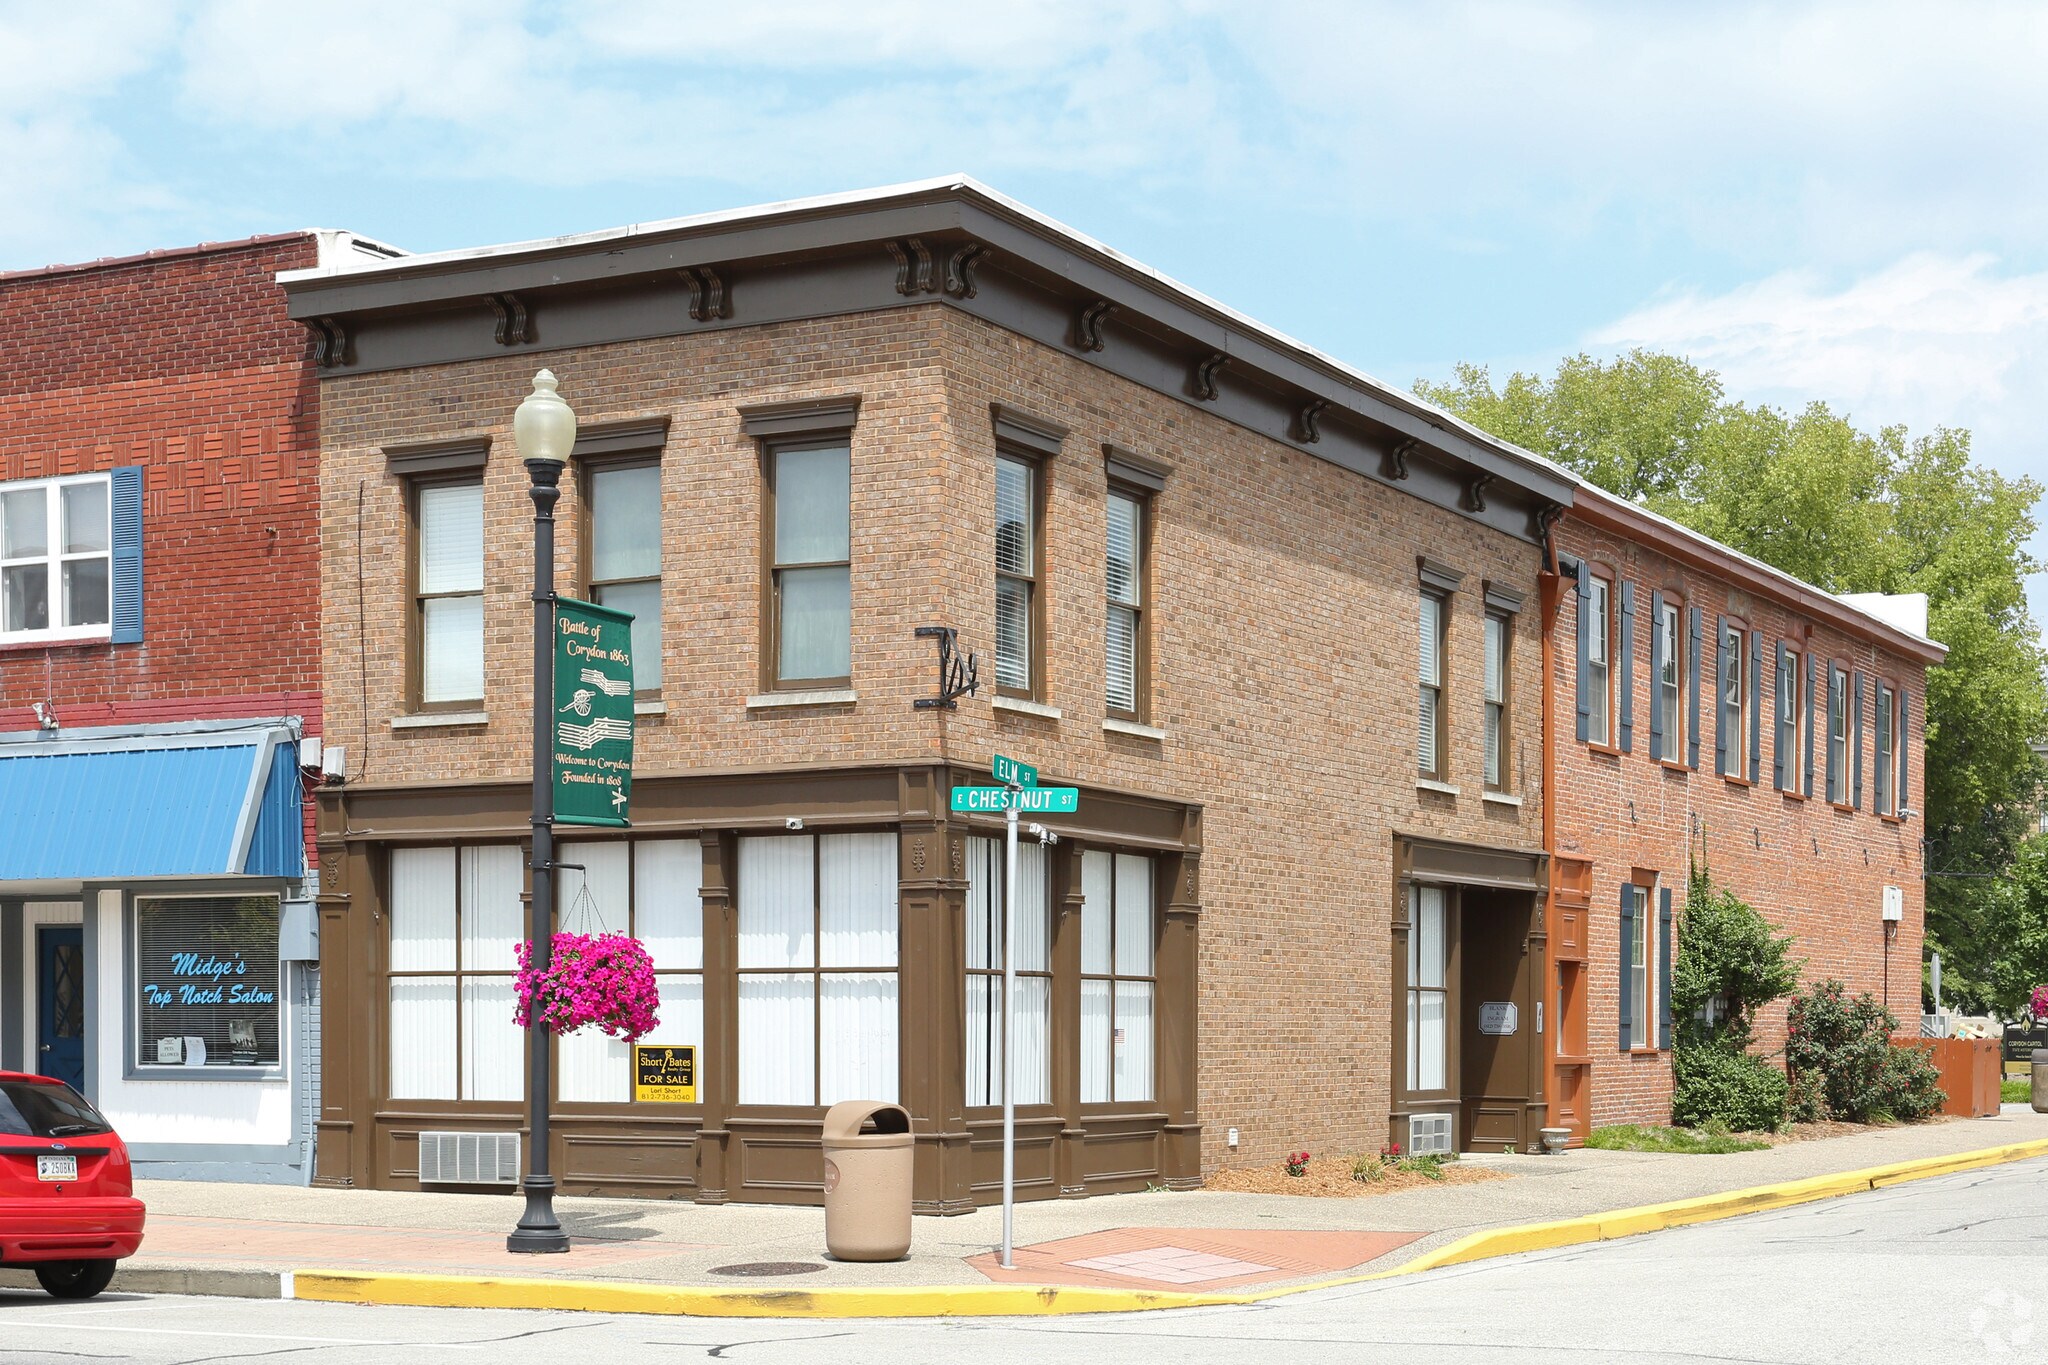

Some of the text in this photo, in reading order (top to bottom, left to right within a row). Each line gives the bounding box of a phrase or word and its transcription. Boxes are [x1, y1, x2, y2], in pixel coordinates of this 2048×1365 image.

[559, 617, 602, 643] Battle of
[566, 639, 630, 666] Corydon 1863
[555, 753, 630, 773] Welcome to Corydon
[999, 759, 1031, 782] ELM ST
[561, 770, 622, 786] Founded in 1808
[957, 790, 1072, 809] E CHESTNUT ST
[171, 952, 246, 982] Midge's
[144, 983, 274, 1009] Top Notch Salon
[640, 1057, 691, 1067] Short Bates
[643, 1075, 688, 1084] FOR SALE
